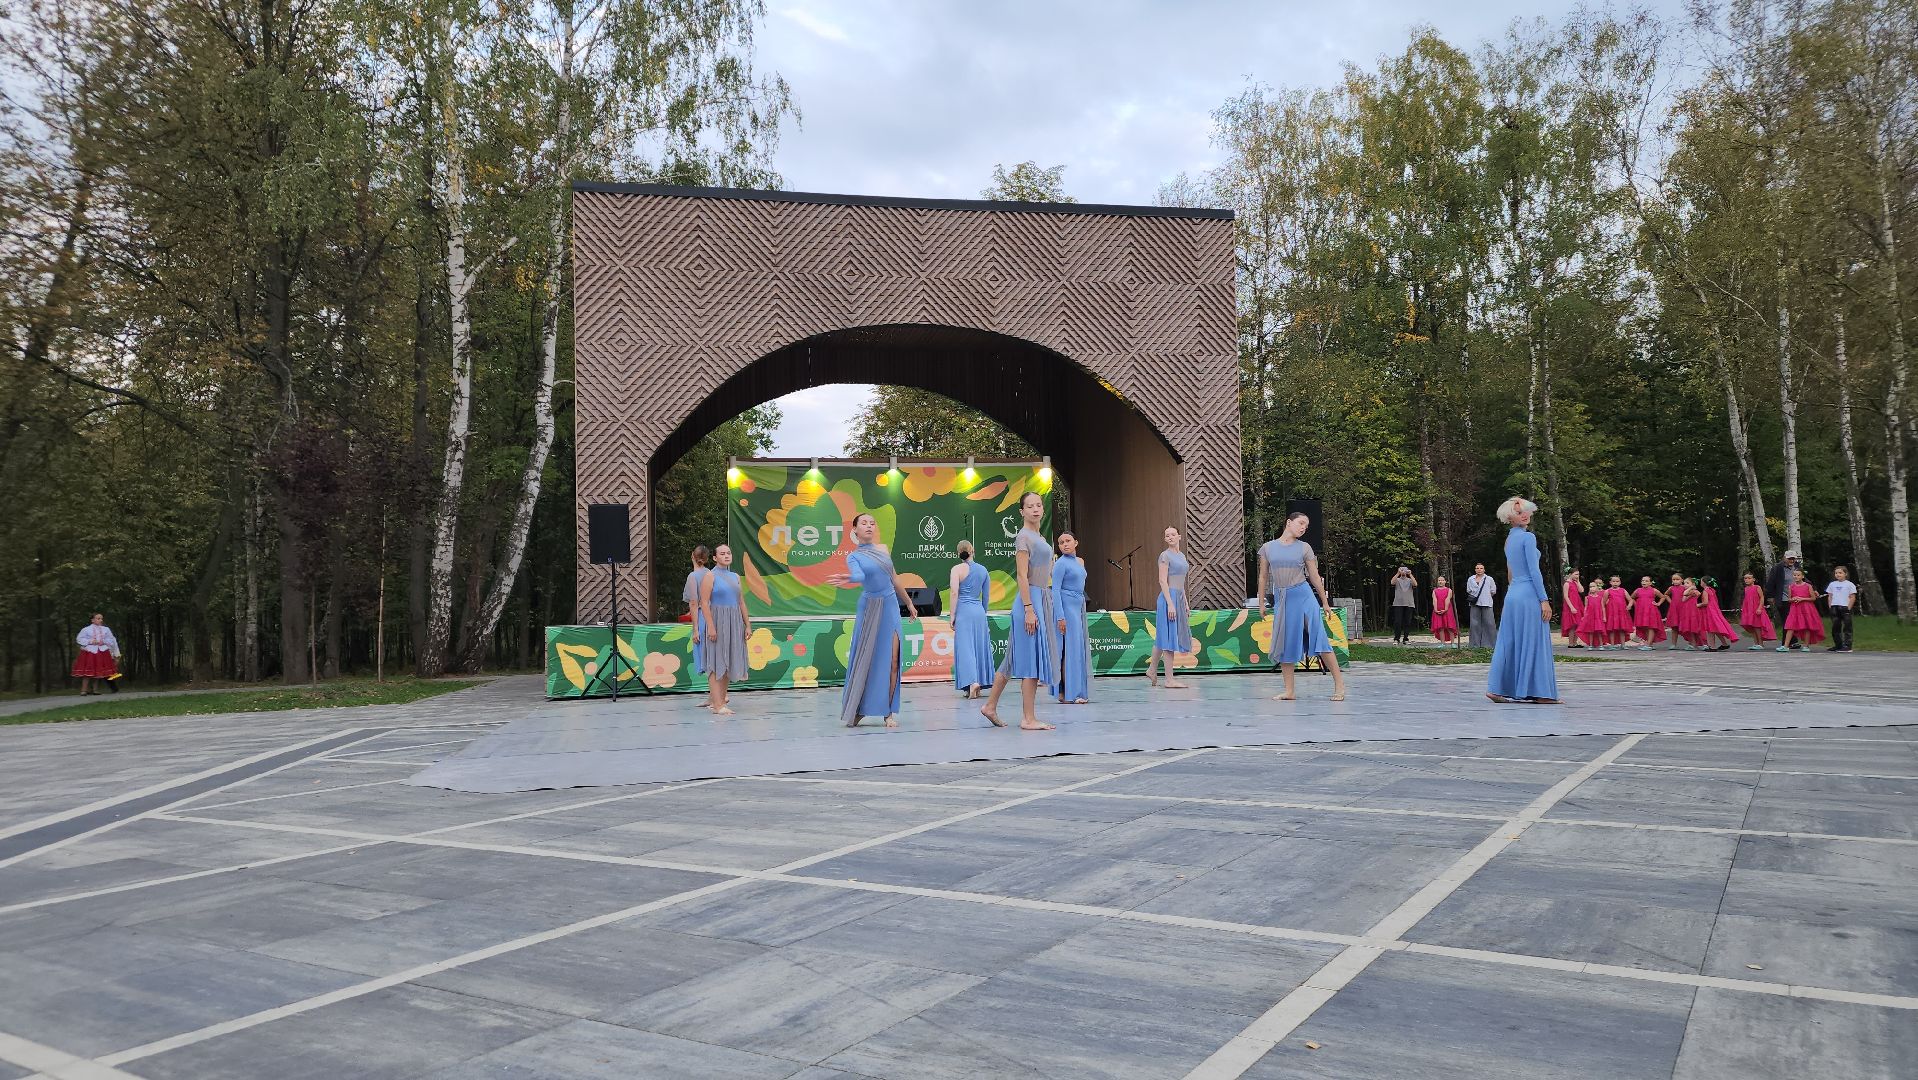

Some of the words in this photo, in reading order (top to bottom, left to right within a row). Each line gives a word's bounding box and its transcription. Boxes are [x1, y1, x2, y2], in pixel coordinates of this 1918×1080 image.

[918, 544, 945, 552] ПАРКИ
[901, 551, 960, 559] ПОДМОСКОВЬ
[994, 548, 1017, 557] Остро
